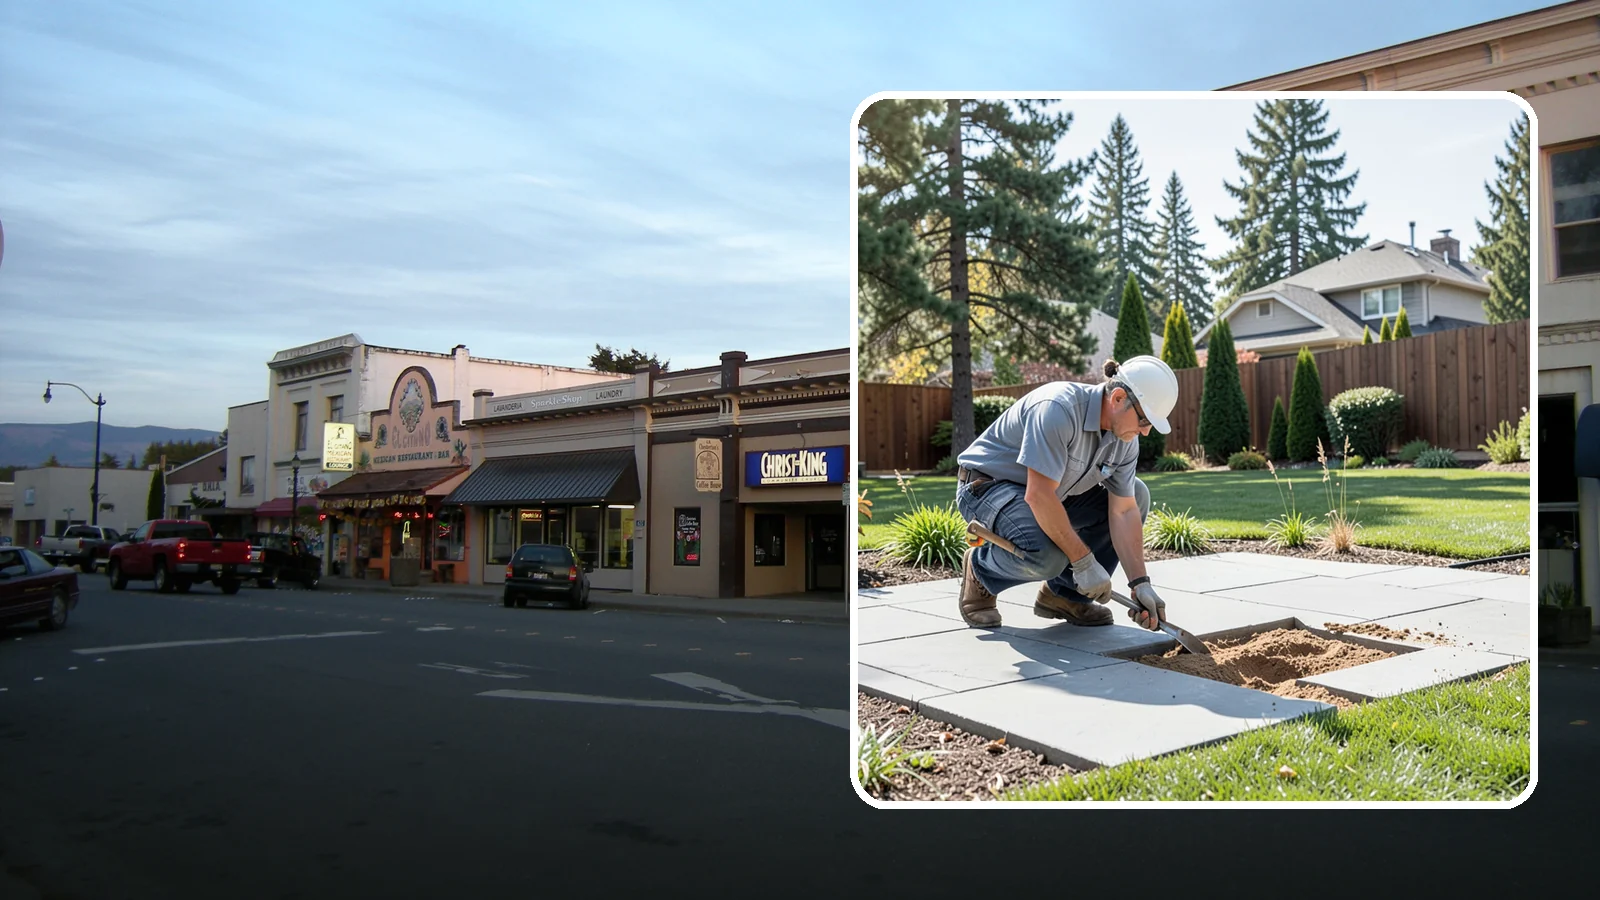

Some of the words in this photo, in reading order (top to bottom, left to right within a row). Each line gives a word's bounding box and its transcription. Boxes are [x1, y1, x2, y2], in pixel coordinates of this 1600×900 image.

[595, 389, 623, 400] LAUNDRY
[493, 402, 522, 412] LAVANDERIA
[530, 397, 561, 409] Sparkle
[562, 394, 582, 404] Shop
[373, 455, 396, 464] MEXICAN
[397, 451, 433, 462] RESTAURANT
[438, 450, 450, 459] BAR
[761, 452, 797, 478] CHRIST
[799, 450, 827, 476] KING
[697, 481, 709, 489] Coffee
